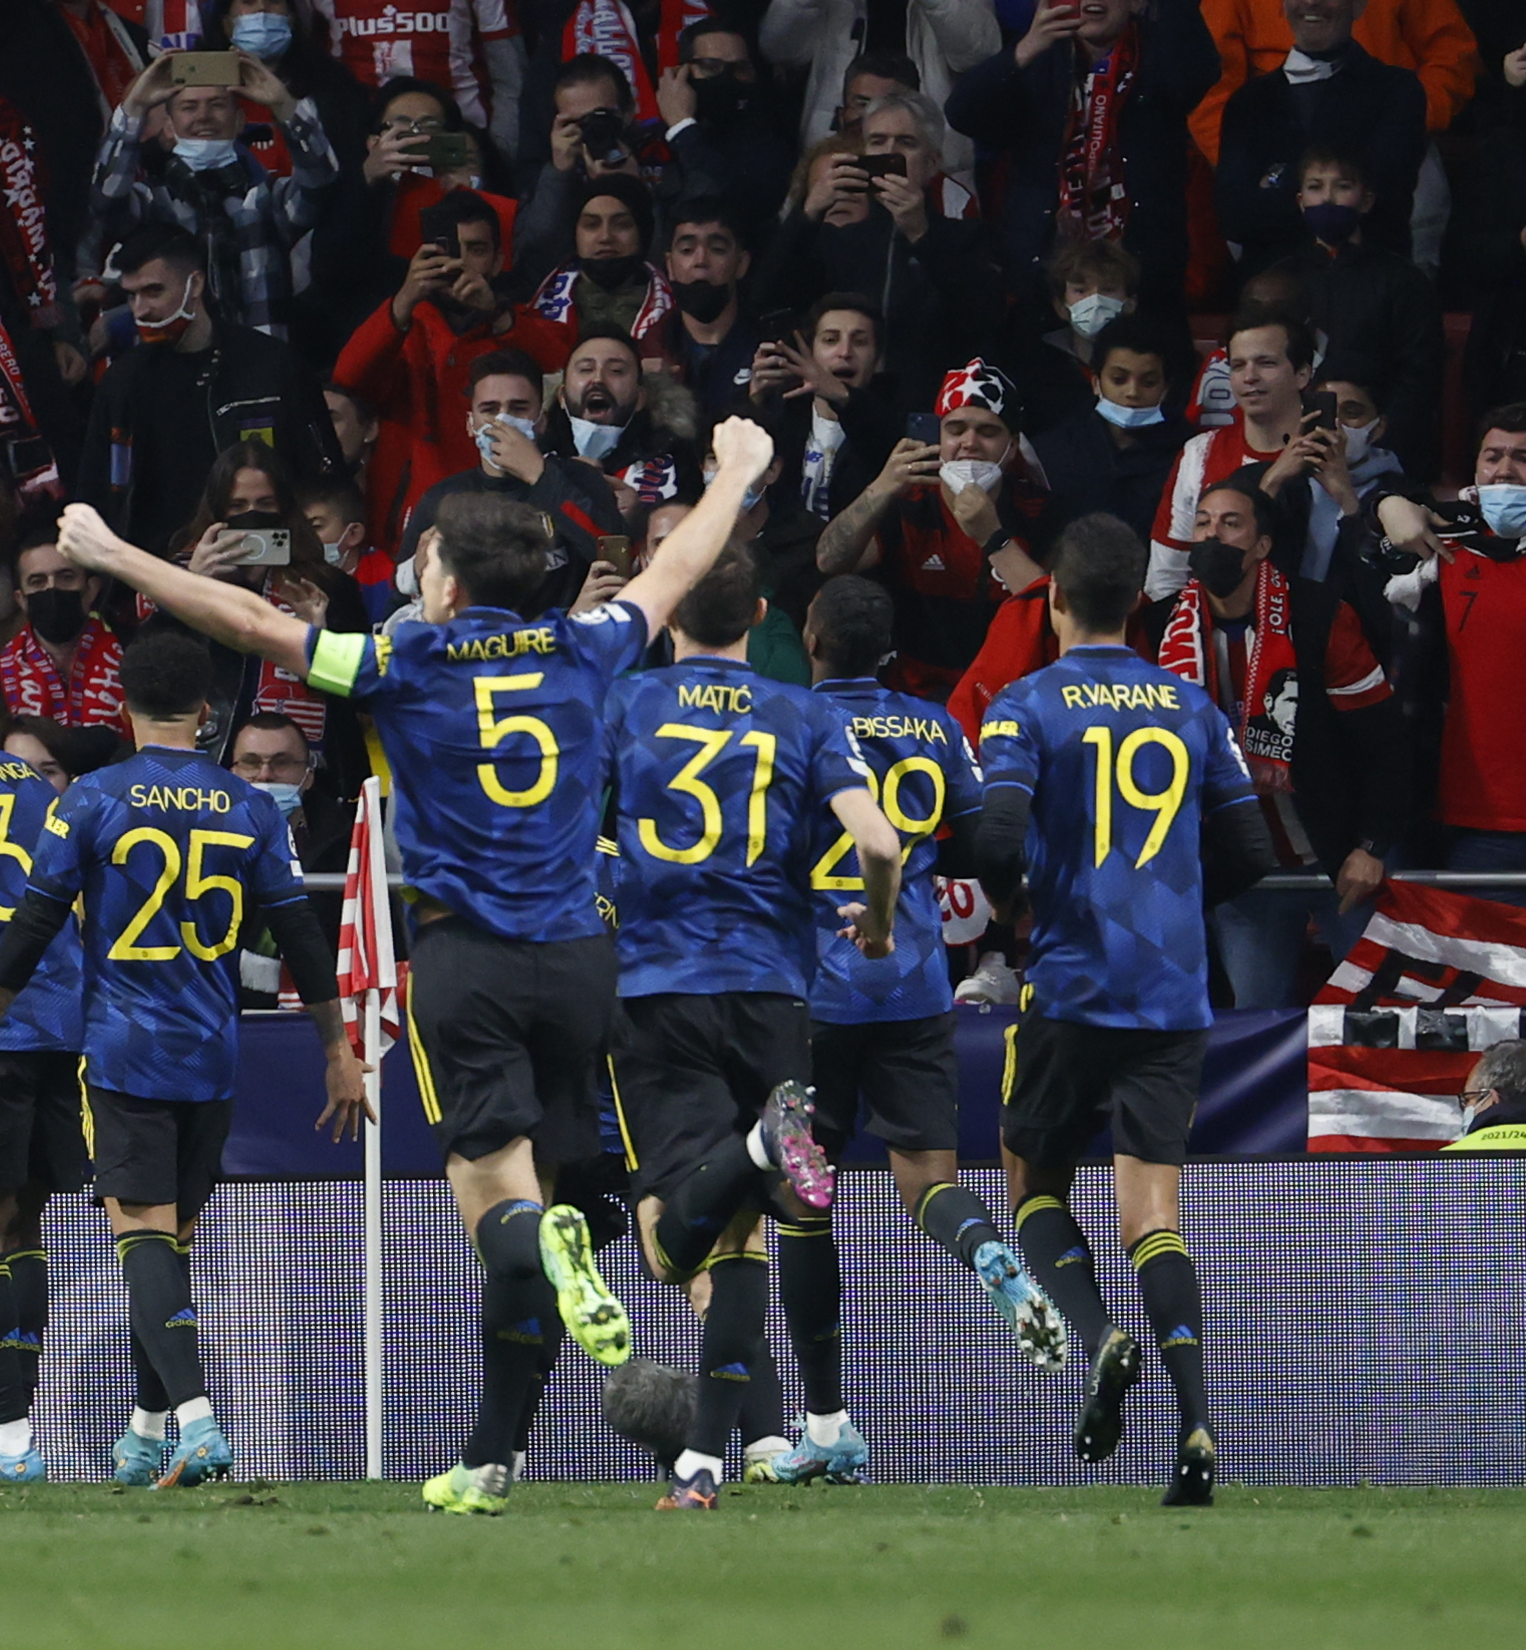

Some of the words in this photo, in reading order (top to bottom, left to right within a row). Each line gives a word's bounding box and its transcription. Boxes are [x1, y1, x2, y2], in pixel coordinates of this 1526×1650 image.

[335, 12, 451, 37] Plus500
[1458, 591, 1479, 633] 7
[447, 627, 557, 662] MAGUIRE
[678, 683, 753, 716] MATIĆ
[1061, 683, 1181, 711] R.VARANE
[473, 672, 560, 808] 5
[851, 715, 948, 746] BISSAKA
[1246, 727, 1293, 746] DIEGO
[131, 784, 231, 813] SANCHO
[637, 722, 778, 868] 31
[1081, 726, 1190, 870] 19
[107, 826, 256, 962] 25
